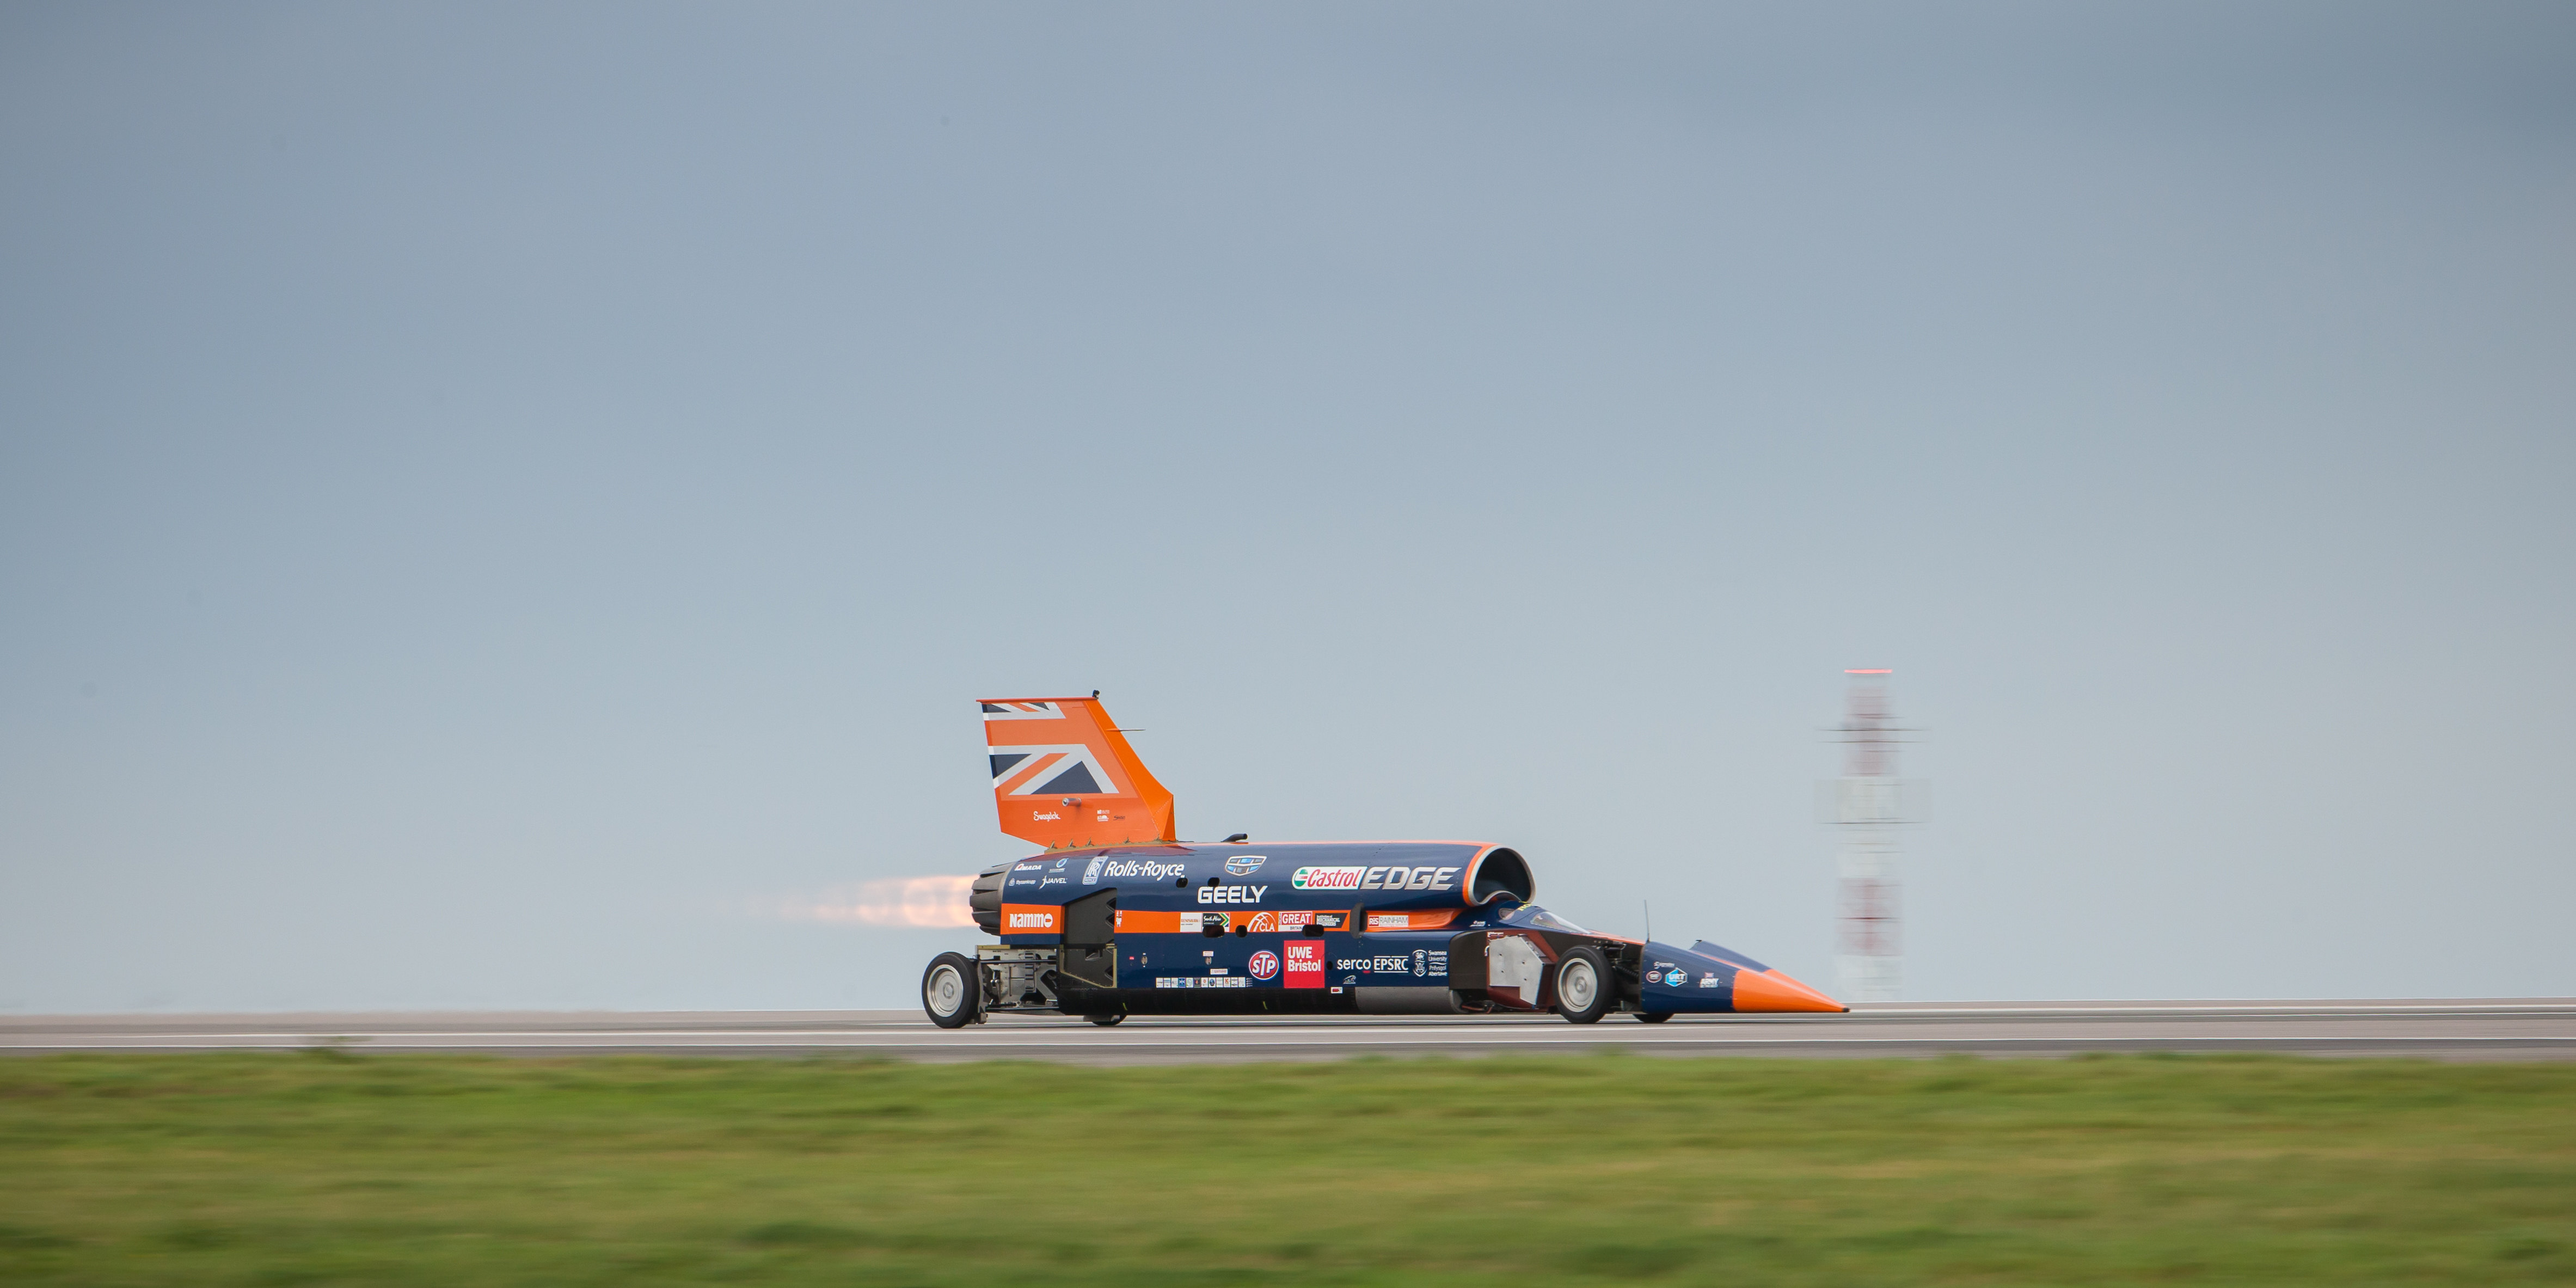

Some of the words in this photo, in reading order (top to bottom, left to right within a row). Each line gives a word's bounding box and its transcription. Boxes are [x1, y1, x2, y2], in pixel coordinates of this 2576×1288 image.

[1033, 811, 1061, 822] Swagelok
[1104, 860, 1185, 881] Rolls-Royce
[1307, 869, 1361, 888] Castrol
[1360, 866, 1462, 890] EDGE
[1198, 885, 1268, 904] GEELY
[1282, 913, 1311, 924] GREAT
[1259, 923, 1275, 932] CLA
[1287, 946, 1312, 959] UWE
[1252, 954, 1276, 976] STP
[1287, 959, 1321, 972] Bristol
[1336, 959, 1371, 970] serco
[1373, 958, 1409, 971] EPSRC
